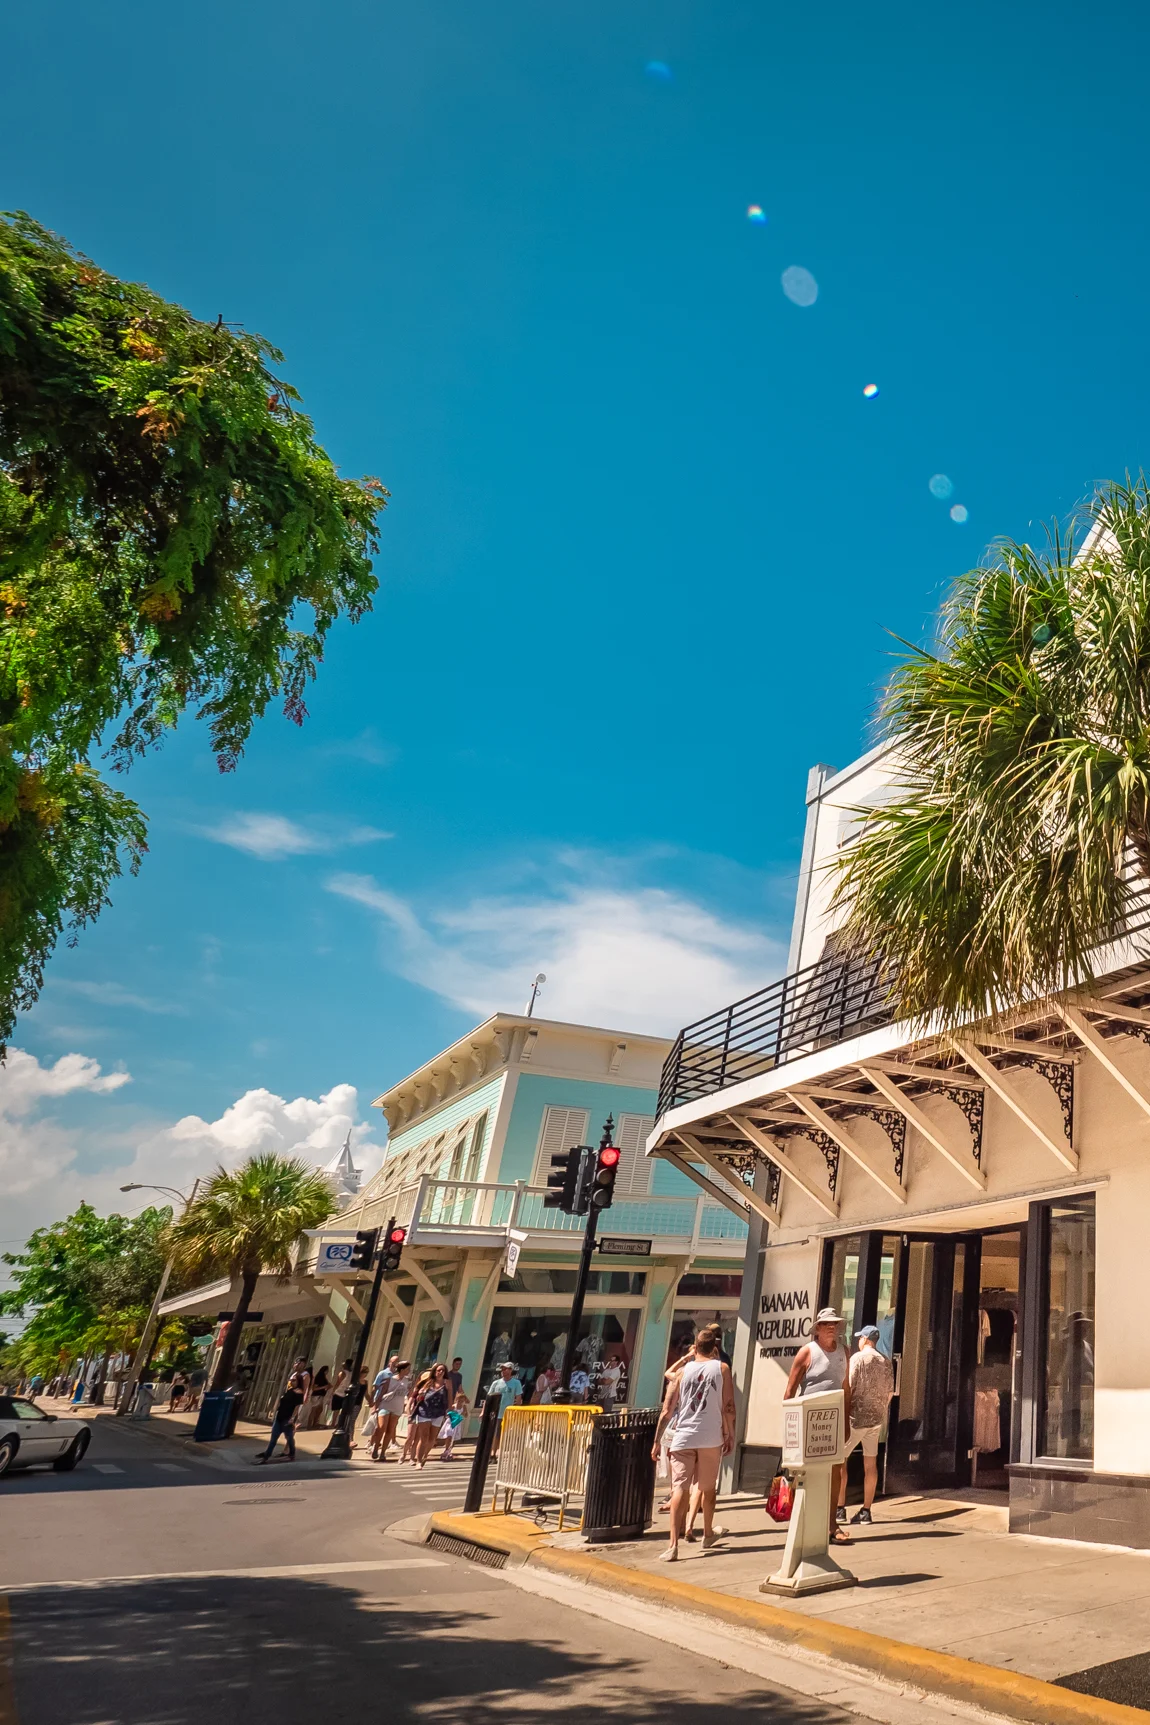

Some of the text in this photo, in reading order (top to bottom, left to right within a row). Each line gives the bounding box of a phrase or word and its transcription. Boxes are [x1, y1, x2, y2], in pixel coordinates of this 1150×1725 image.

[607, 1242, 635, 1251] Fleming
[761, 1289, 810, 1315] BANANA
[756, 1316, 812, 1341] REPUBLIC
[759, 1346, 783, 1359] FACTORY
[810, 1411, 836, 1421] FREE
[812, 1423, 832, 1431] Money
[811, 1434, 832, 1442] Saving
[807, 1445, 835, 1454] Coupons
